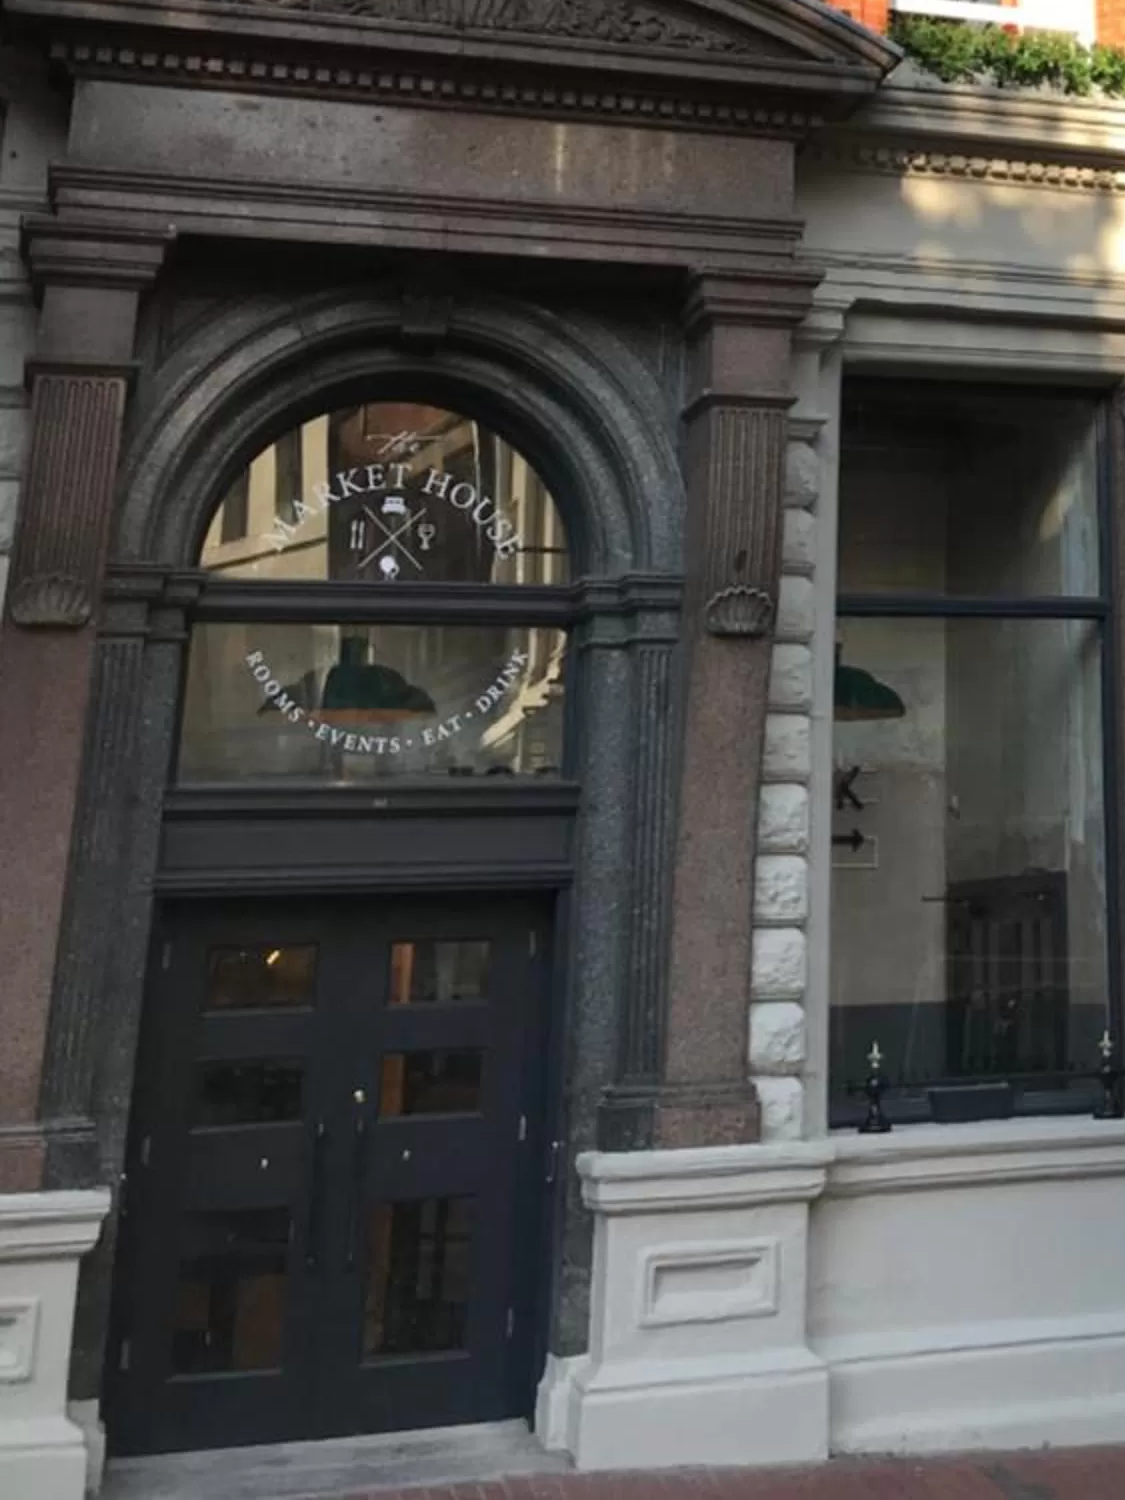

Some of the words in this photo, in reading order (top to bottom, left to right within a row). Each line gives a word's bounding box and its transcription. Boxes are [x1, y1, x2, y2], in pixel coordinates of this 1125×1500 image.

[260, 463, 413, 552] MARKET
[420, 467, 521, 561] HOUSE
[245, 651, 306, 724] ROOMS
[315, 723, 401, 754] EVENTS
[421, 714, 462, 746] EAT
[475, 647, 528, 714] DRINK
